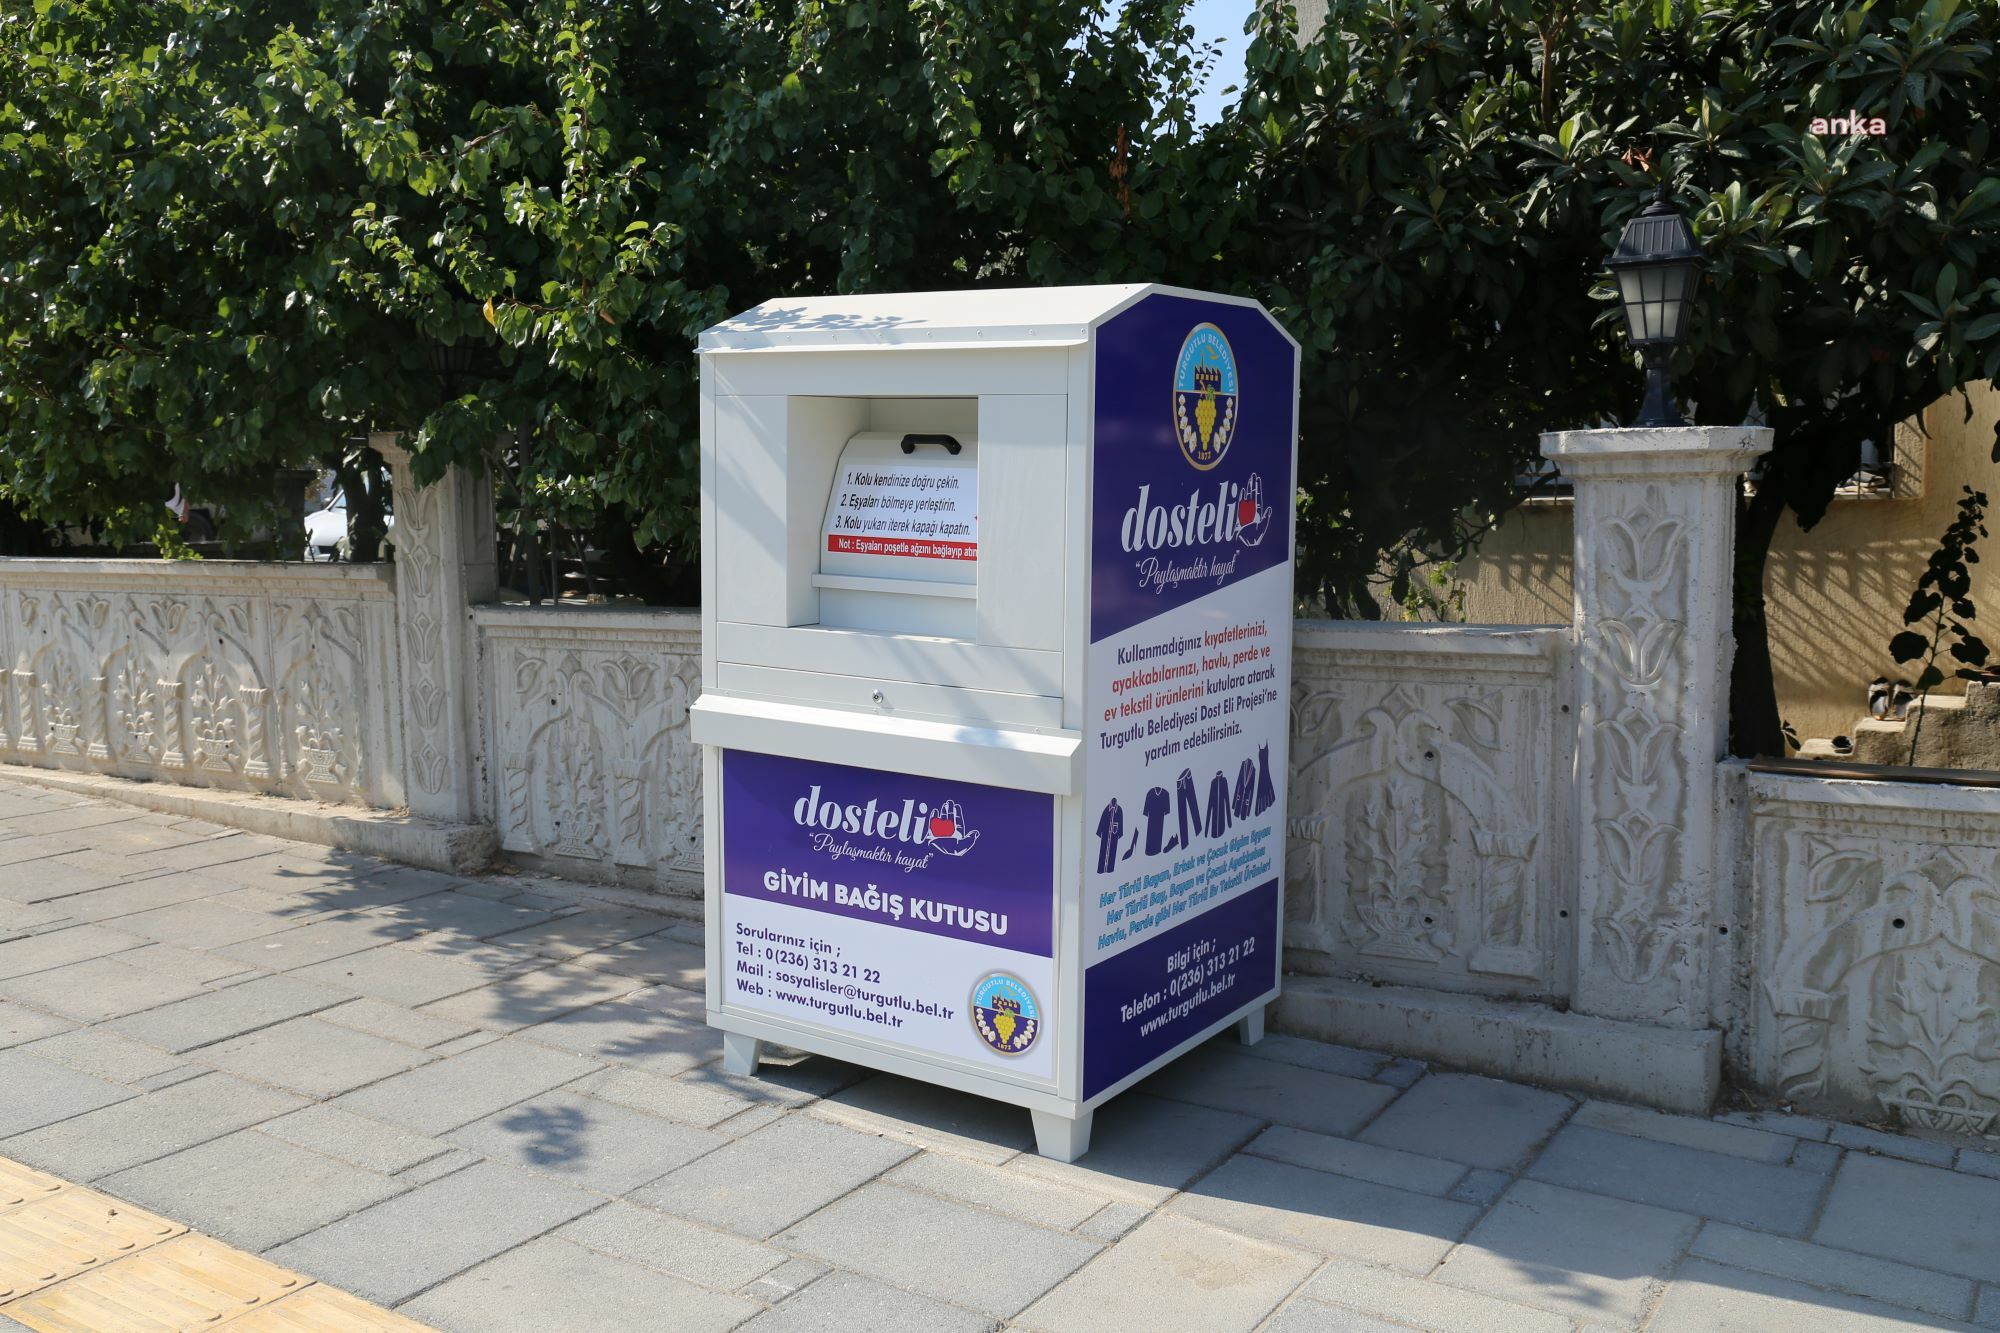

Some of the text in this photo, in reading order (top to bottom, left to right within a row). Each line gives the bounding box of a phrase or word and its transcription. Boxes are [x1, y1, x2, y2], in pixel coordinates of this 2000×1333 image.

[1179, 334, 1206, 388] TURGUTLU
[841, 494, 956, 514] 2. Eşyaları bölmeye yerleştirin.
[847, 472, 959, 492] 1. Kolu kendinize doğru çekin.
[836, 515, 970, 537] 3. Kolu yukarı iterek kapağı kapatın.
[1121, 480, 1238, 553] dosteli
[839, 538, 851, 549] Not
[856, 540, 883, 552] Eşyaları
[884, 543, 909, 555] poşetle
[911, 543, 931, 556] ağzını
[933, 543, 962, 558] bağlayıp
[1118, 620, 1268, 665] Kullanmadığınız kıyafetlerinizi,
[1104, 664, 1276, 721] ev tekstil ürünlerini kutulara atarak
[1112, 645, 1271, 696] ayakkabılarınızı, havlu, perde ve
[1100, 688, 1278, 750] Turgutlu Belediyesi Dost Eli Projesi’ne
[1145, 721, 1243, 767] yardım edebilirsiniz.
[793, 785, 929, 845] dosteli
[1100, 891, 1117, 908] Her
[1119, 877, 1142, 900] Türlü
[1143, 869, 1172, 889] Bayan,
[1173, 856, 1195, 876] Erkek
[1197, 854, 1206, 866] ve
[1207, 842, 1229, 866] Çocuk
[1107, 909, 1124, 926] Her
[1125, 894, 1148, 917] Türlü
[1170, 878, 1195, 898] Bayan
[1196, 873, 1205, 886] ve
[1206, 860, 1228, 886] Çocuk
[763, 867, 1008, 936] GİYİM BAĞIŞ KUTUSU
[1098, 927, 1127, 951] Havlu,
[1129, 913, 1154, 936] Perde
[1172, 900, 1188, 917] Her
[1188, 886, 1209, 908] Türlü
[1209, 883, 1220, 898] Ev
[1220, 871, 1244, 894] Tekstil
[736, 923, 806, 949] Sorularınız
[809, 937, 833, 956] için
[736, 941, 754, 957] Tel
[813, 957, 838, 975] 313
[842, 963, 858, 979] 21
[864, 968, 881, 984] 22
[1167, 944, 1191, 974] Bilgi
[1192, 939, 1210, 964] için
[736, 978, 764, 997] Web
[775, 988, 903, 1028] www.turgutlu.bel.tr
[737, 960, 764, 978] Mail
[775, 969, 954, 1020] sosyalisler@turgutlu.bel.tr
[976, 978, 1004, 1005] TURGUTLU
[1120, 989, 1161, 1024] Telefon
[1170, 962, 1204, 997] 0(236)
[1207, 953, 1226, 977] 313
[1228, 947, 1240, 966] 21
[1243, 936, 1256, 955] 22
[1140, 972, 1236, 1038] www.turgutlu.bel.tr
